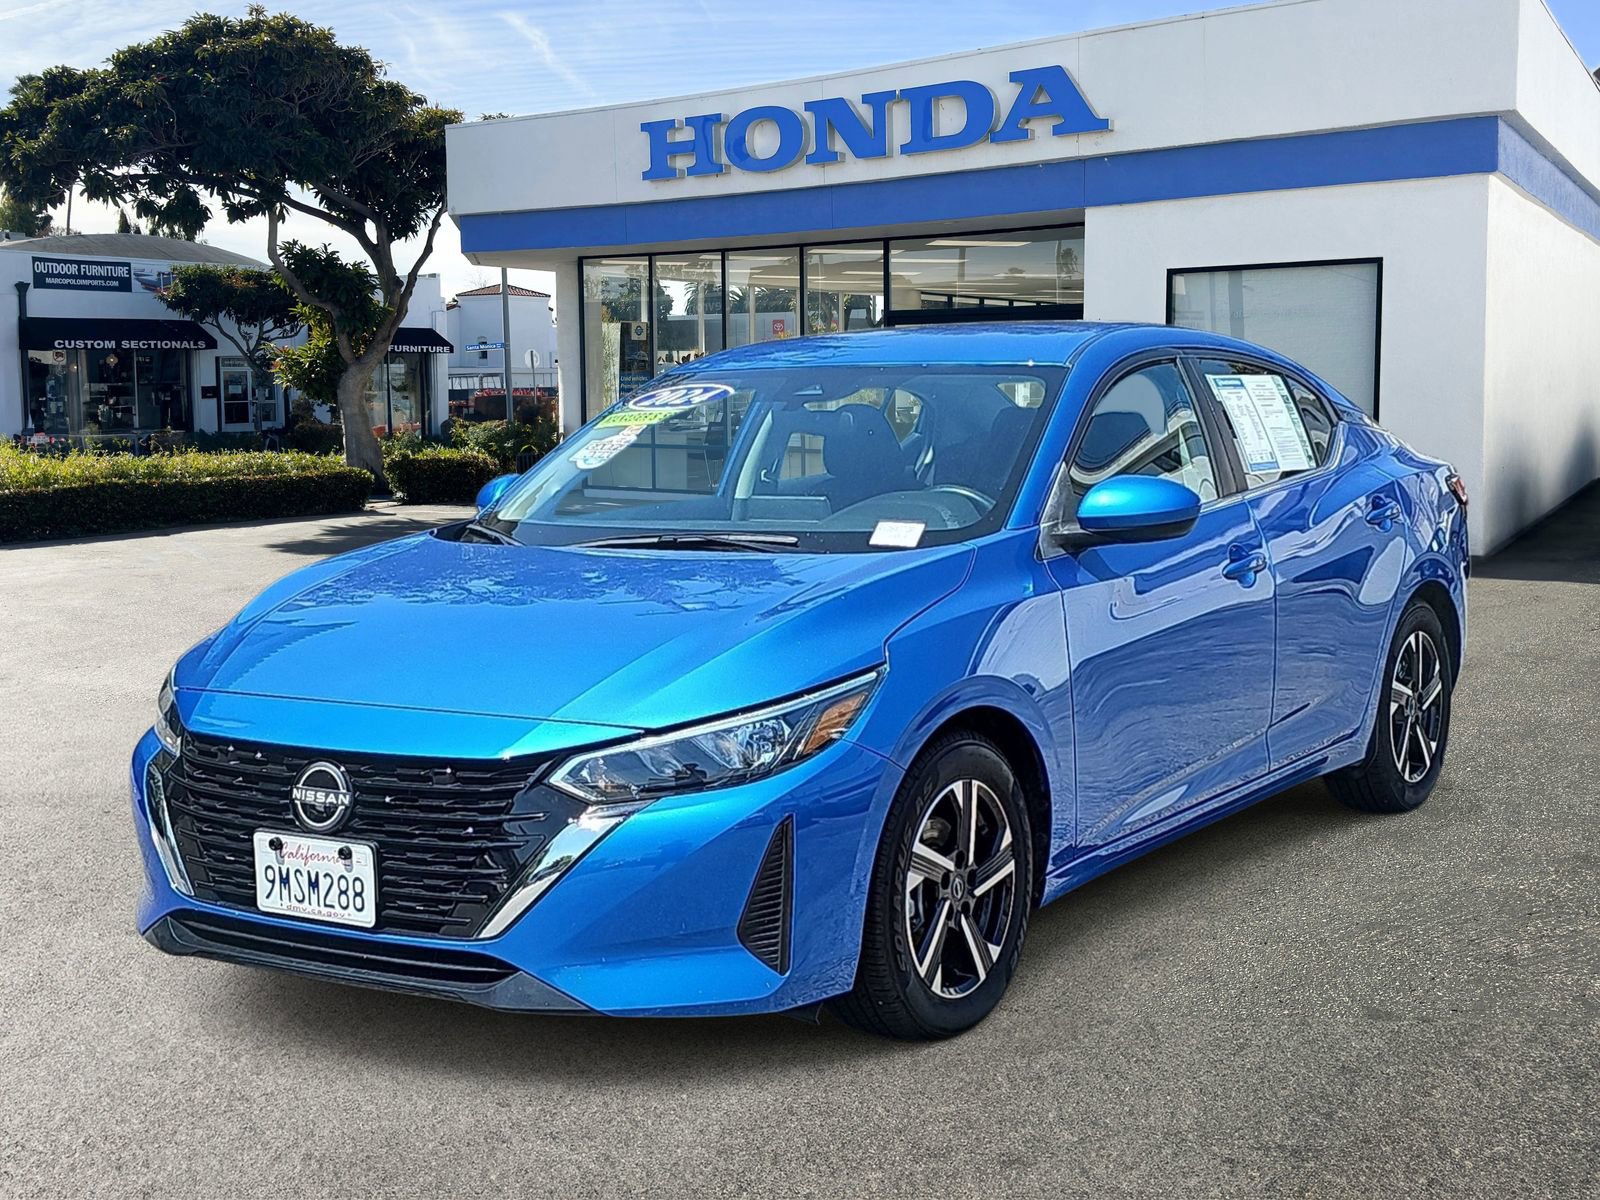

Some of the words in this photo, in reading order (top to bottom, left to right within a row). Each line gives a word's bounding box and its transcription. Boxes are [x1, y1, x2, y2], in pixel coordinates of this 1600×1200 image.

[640, 65, 1112, 182] HONDA
[34, 262, 78, 275] OUTDOOR
[80, 264, 130, 277] FURNITURE
[45, 277, 119, 286] MARCOPOLOIMPORTS.COM
[54, 339, 116, 349] CUSTOM
[121, 340, 206, 349] SECTIONALS
[388, 344, 450, 353] FURNITURE
[292, 787, 350, 805] NISSAN
[264, 865, 365, 912] 9MSM288
[286, 904, 345, 918] dmv.ca.gov
